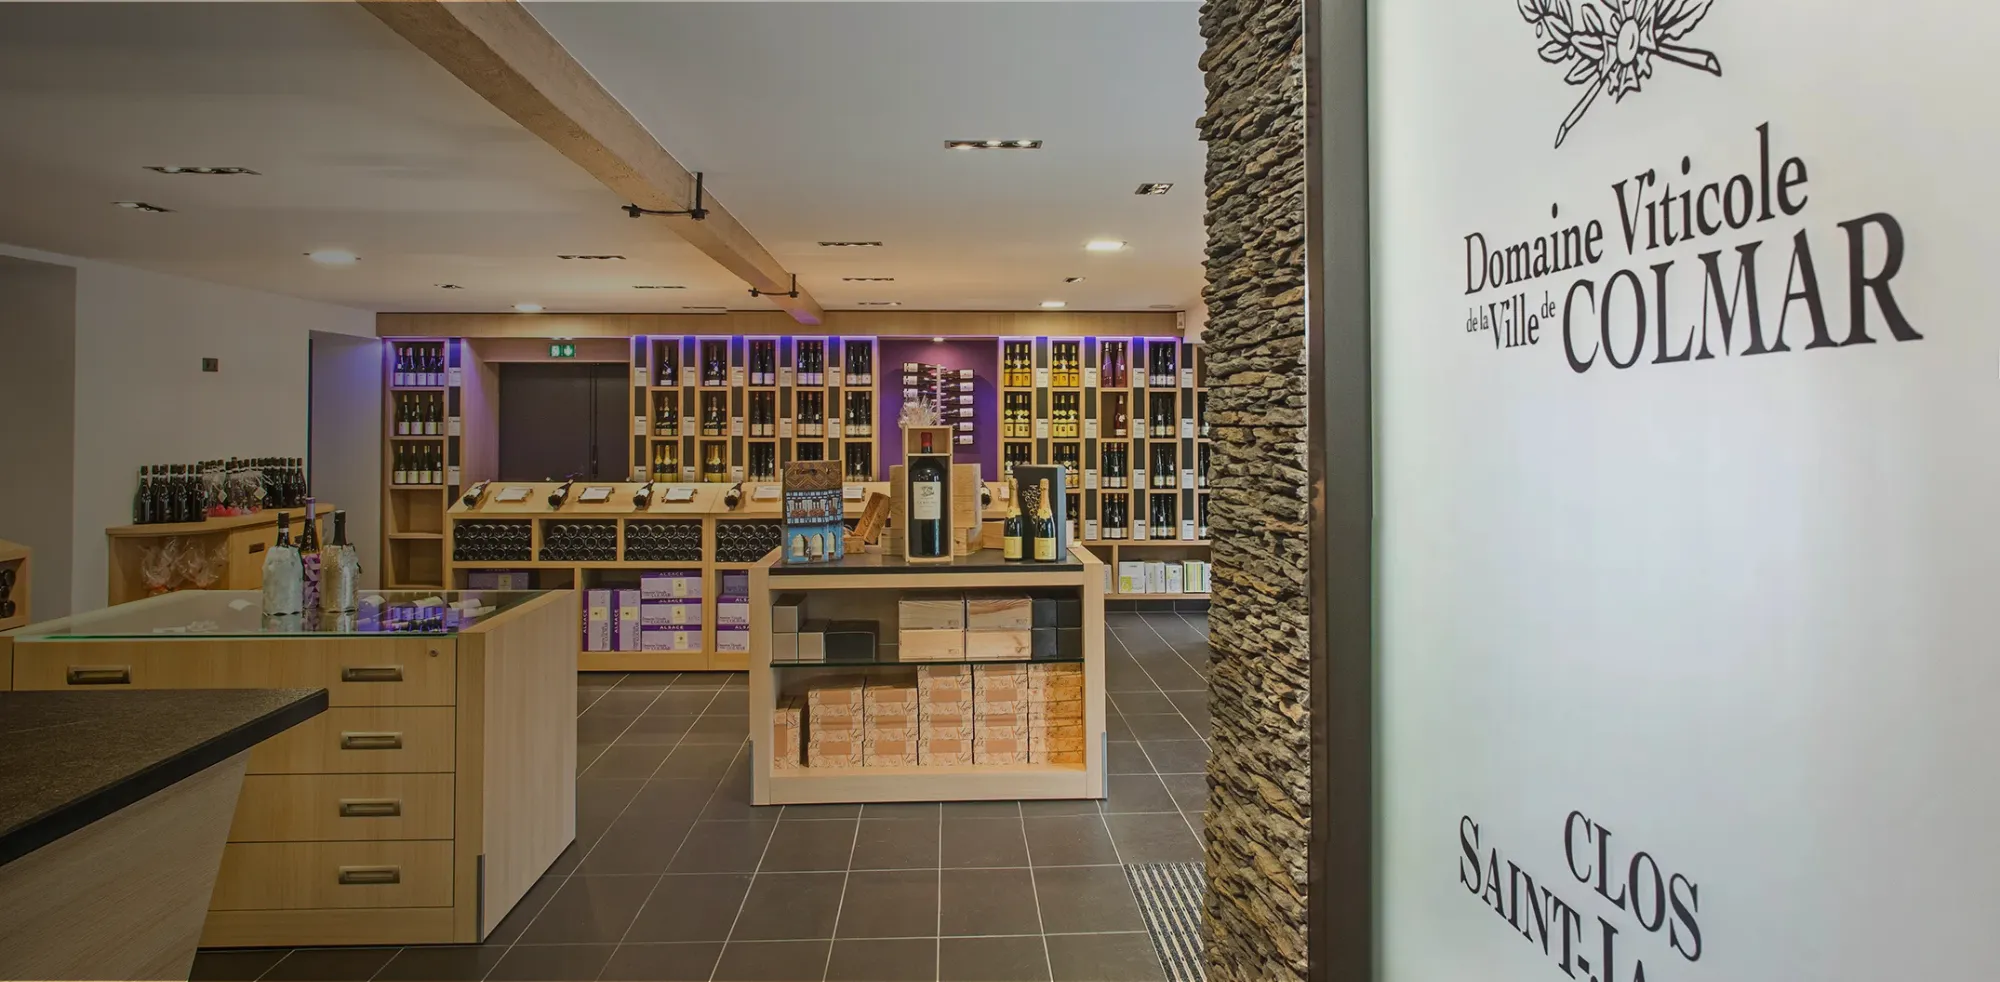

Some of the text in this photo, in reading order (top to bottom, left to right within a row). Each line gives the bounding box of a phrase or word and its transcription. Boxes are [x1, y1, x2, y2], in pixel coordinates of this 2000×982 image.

[1464, 122, 1809, 296] Domaine Viticole
[1466, 212, 1924, 374] de la Ville de COLMAR
[1565, 811, 1702, 962] CLOS
